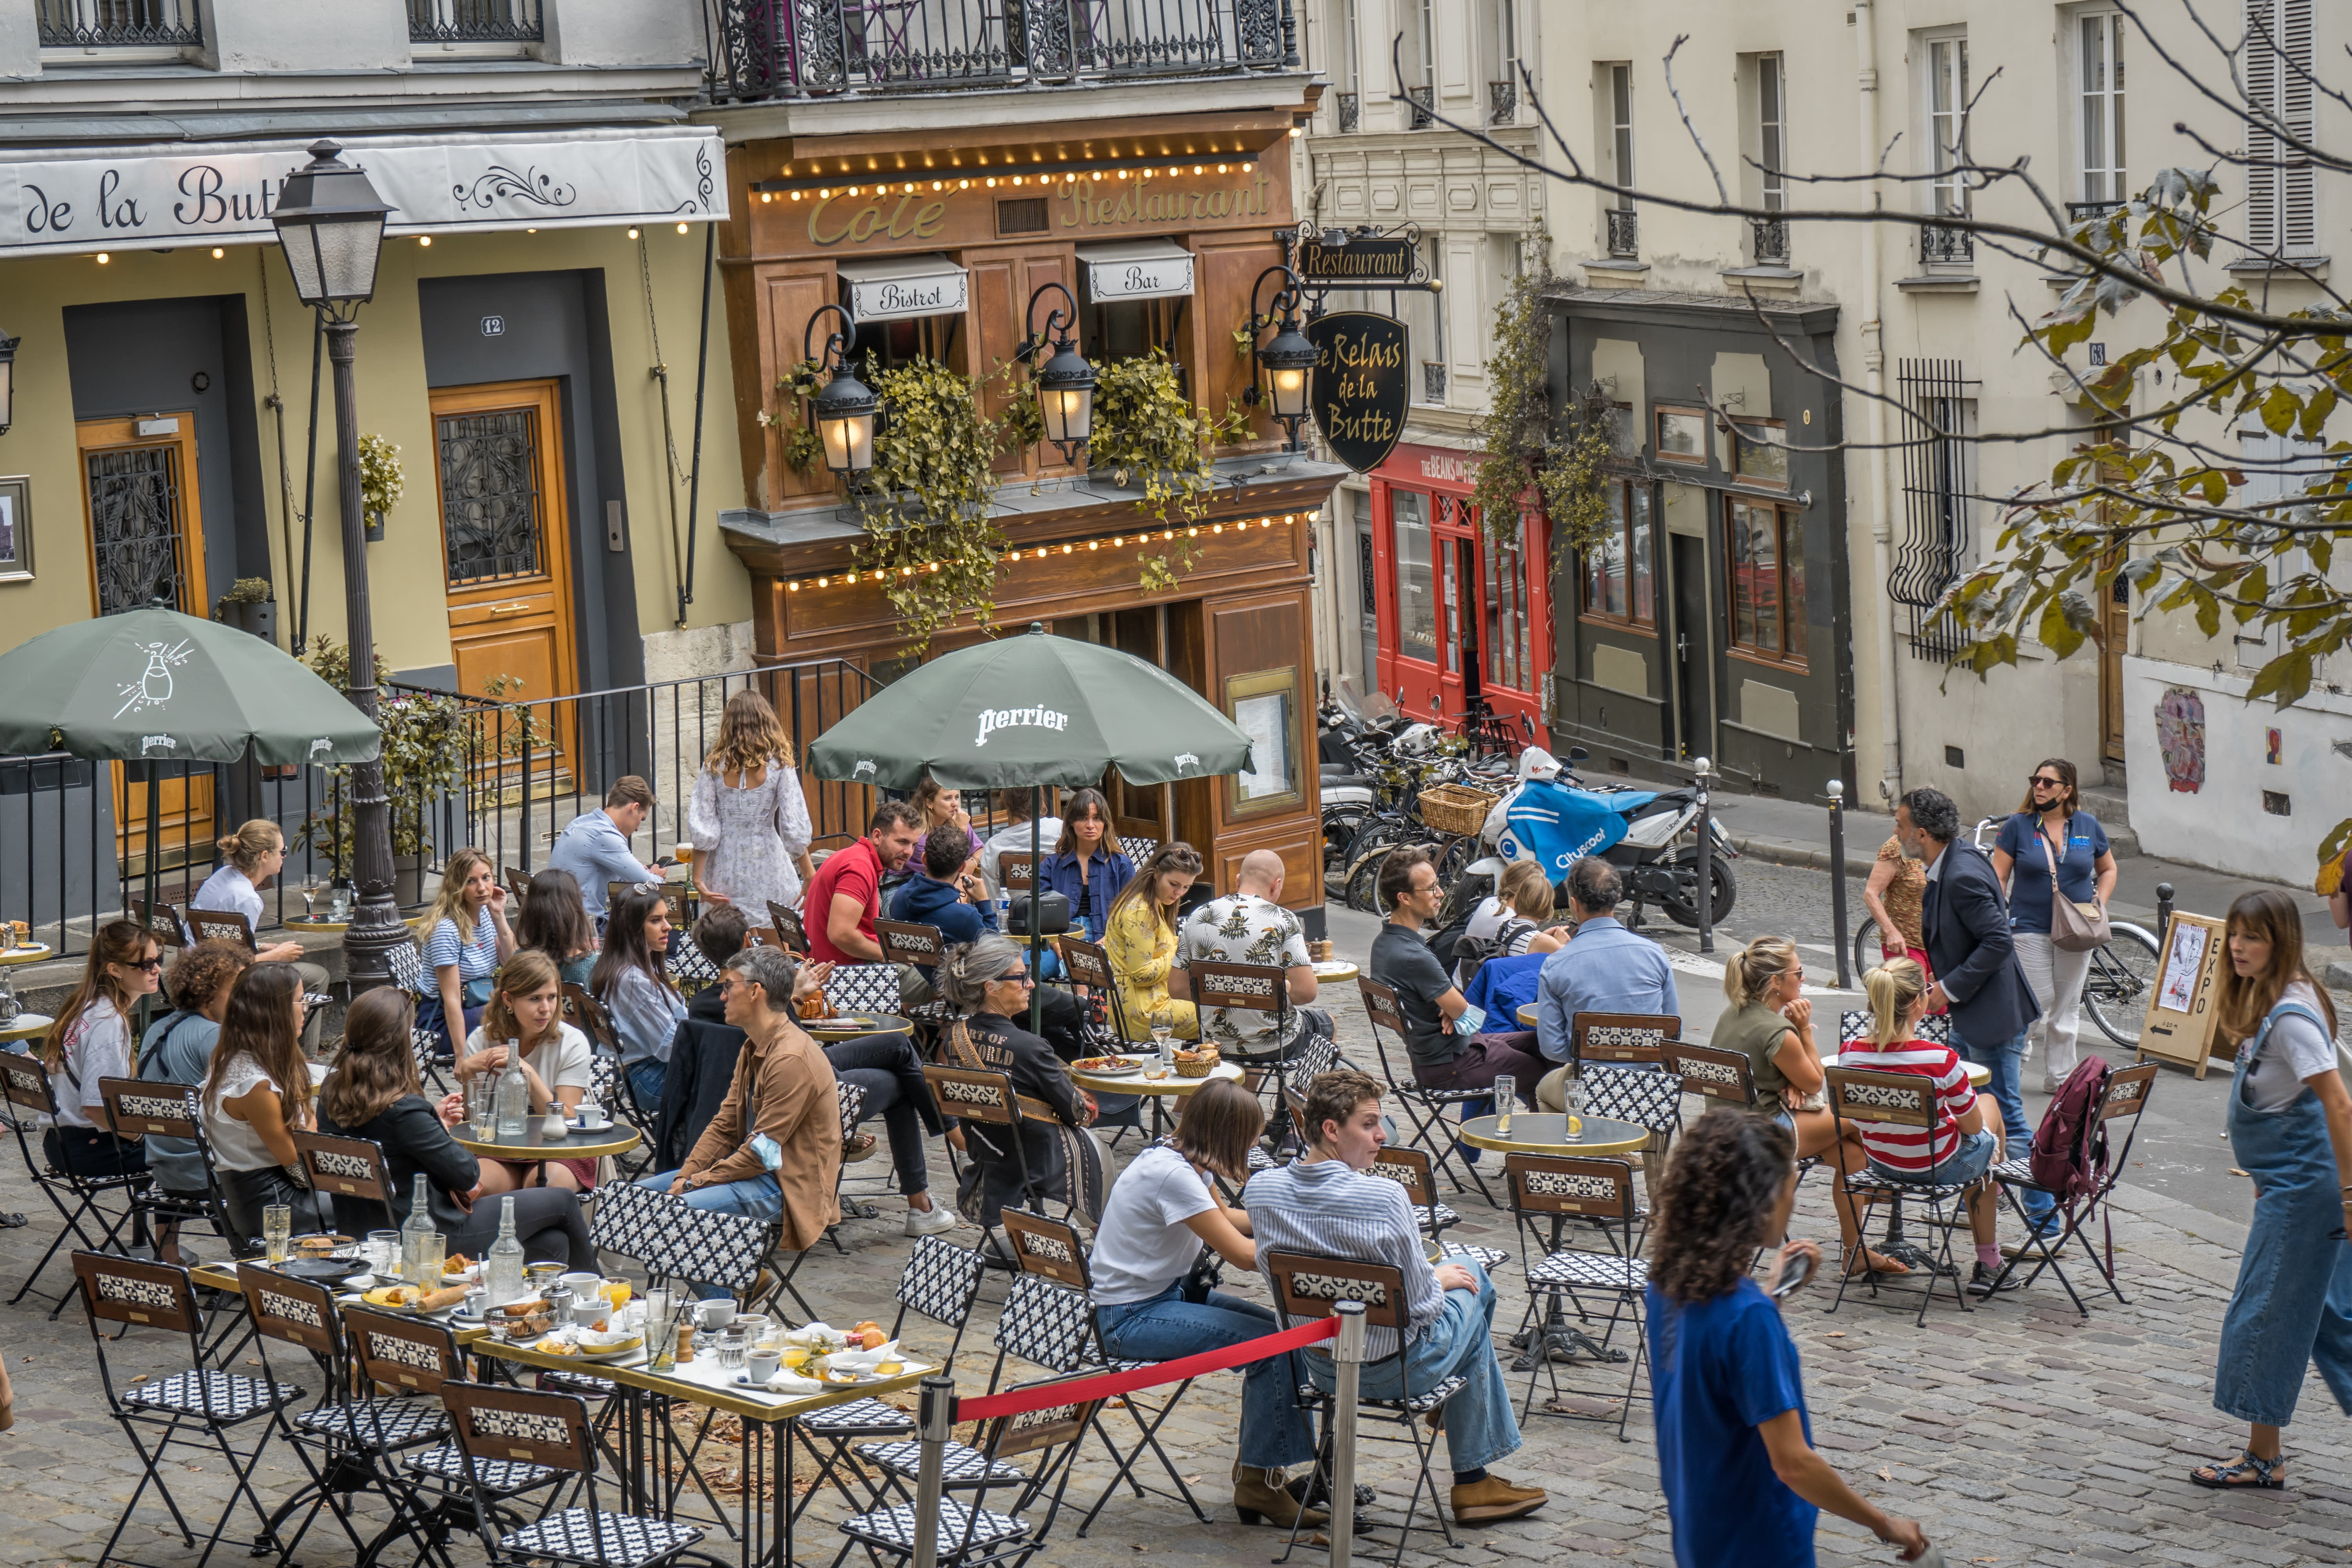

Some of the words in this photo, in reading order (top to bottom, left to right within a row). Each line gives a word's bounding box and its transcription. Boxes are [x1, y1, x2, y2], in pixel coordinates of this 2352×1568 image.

[21, 184, 74, 232] de
[96, 169, 147, 228] la
[174, 165, 285, 225] But
[1057, 171, 1270, 227] Restaurant
[1308, 246, 1404, 275] Restaurant
[1124, 267, 1161, 290] Bar
[880, 284, 942, 310] Bistrot
[485, 319, 501, 333] 12
[1332, 332, 1401, 373] Relais
[2091, 345, 2103, 365] 63
[1339, 372, 1355, 407] de
[1359, 373, 1378, 399] la
[1328, 402, 1393, 443] Butte
[1421, 460, 1431, 477] THE
[1431, 455, 1455, 481] BEANS
[1455, 461, 1463, 477] ON
[975, 704, 1068, 747] perrier
[142, 733, 176, 755] perrier
[310, 737, 333, 759] perrier
[852, 759, 877, 779] perrier
[1174, 751, 1199, 774] perrier
[1666, 818, 1680, 831] Uber
[1555, 827, 1606, 869] Cityscoot
[2196, 938, 2221, 1014] EXPO
[966, 1028, 985, 1041] RT
[988, 1034, 1008, 1045] OF
